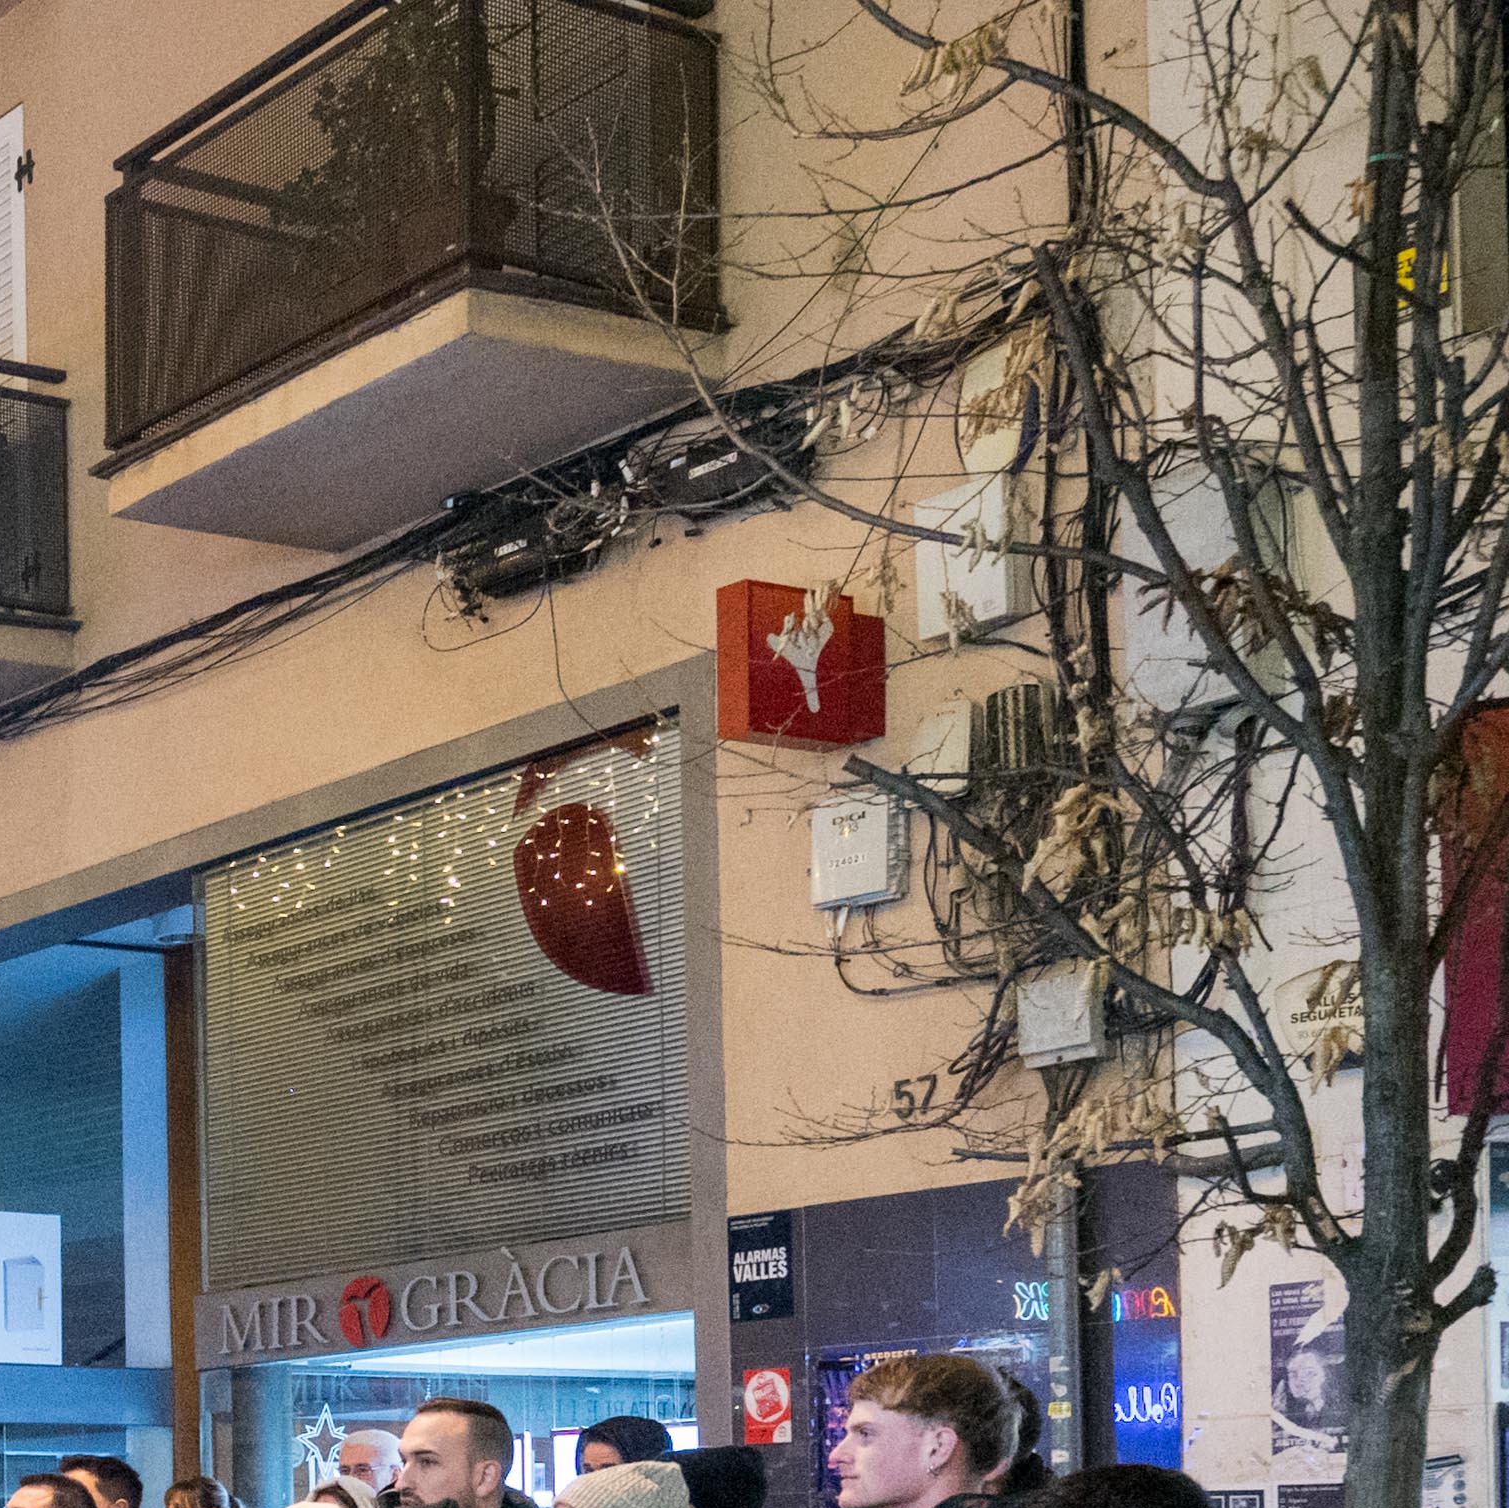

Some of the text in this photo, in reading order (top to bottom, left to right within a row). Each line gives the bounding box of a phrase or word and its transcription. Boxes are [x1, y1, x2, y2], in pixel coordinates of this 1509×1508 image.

[894, 1074, 937, 1119] 57
[733, 1261, 789, 1284] VALLES
[734, 1247, 788, 1266] ALARMAS
[218, 1246, 653, 1355] MIR GRÀCIA
